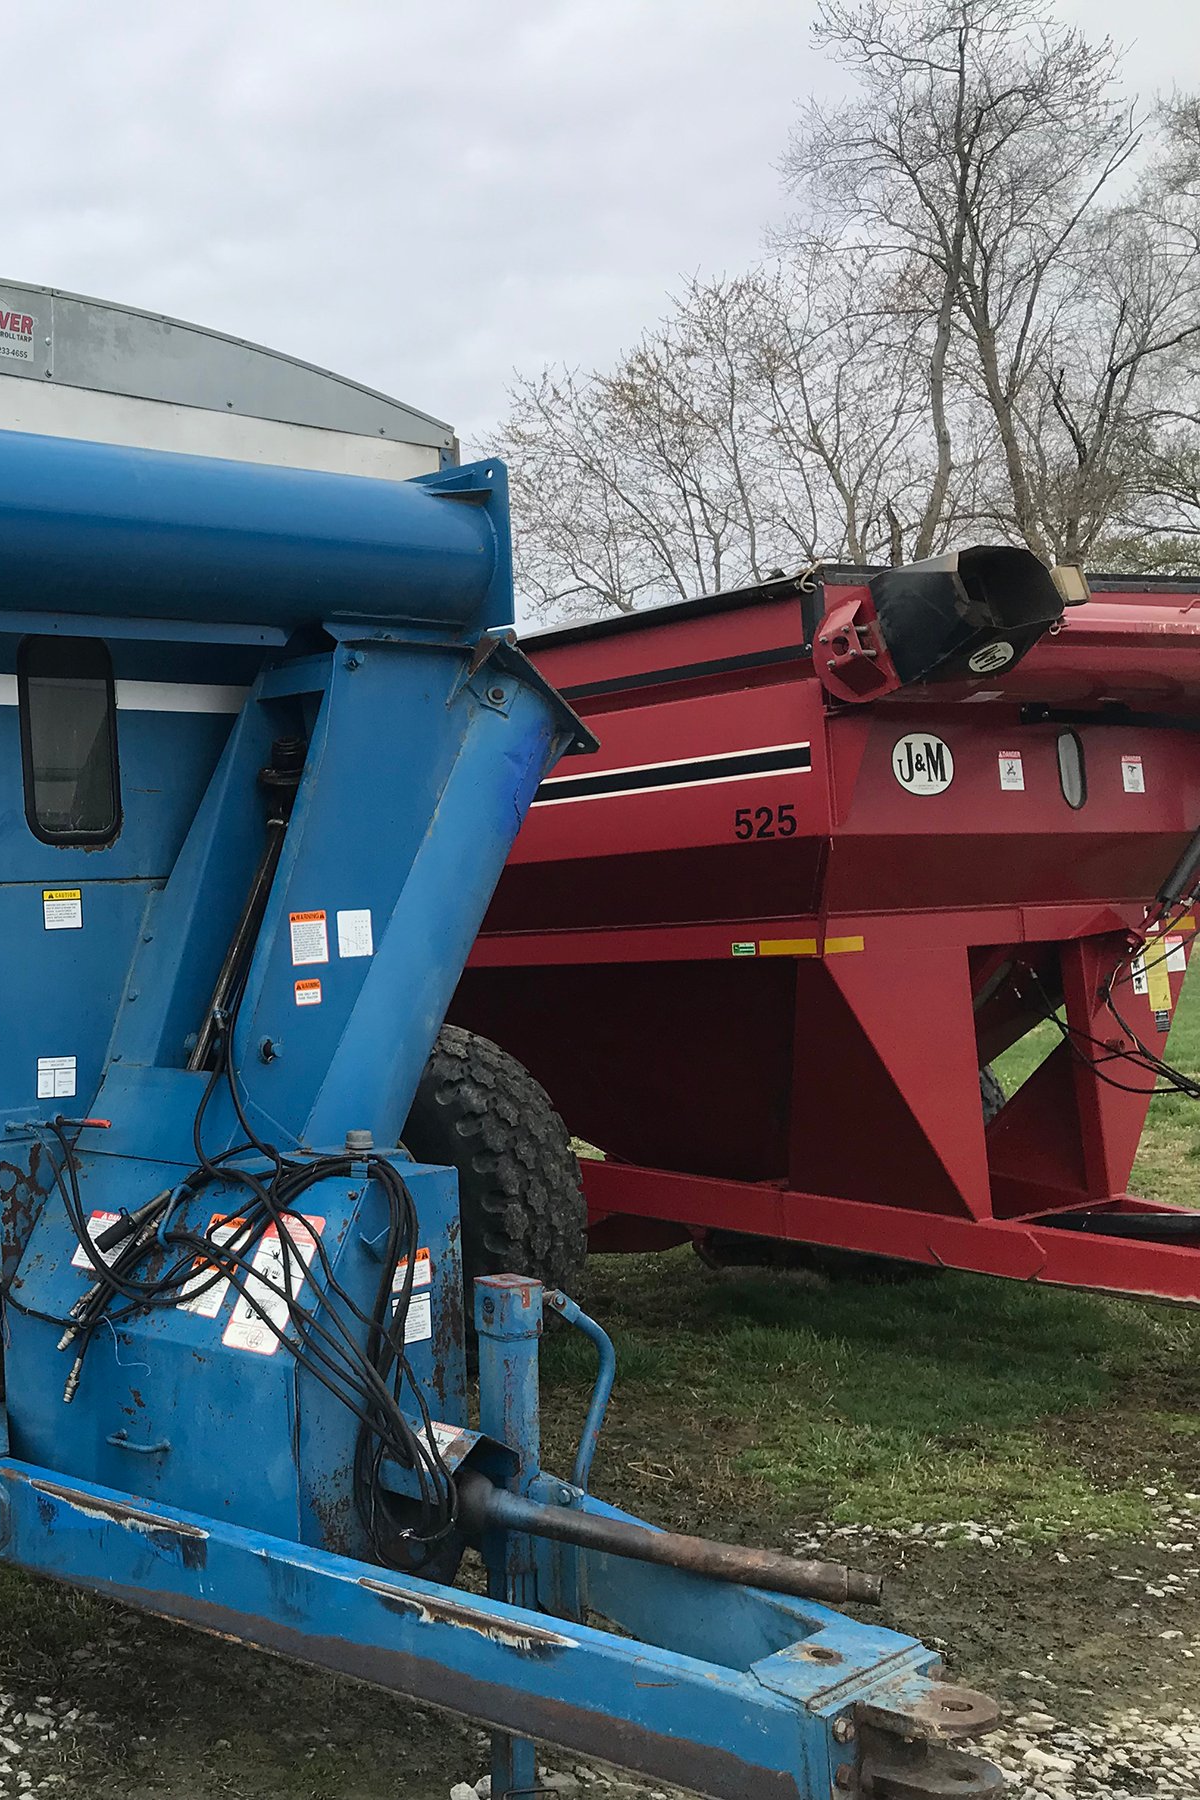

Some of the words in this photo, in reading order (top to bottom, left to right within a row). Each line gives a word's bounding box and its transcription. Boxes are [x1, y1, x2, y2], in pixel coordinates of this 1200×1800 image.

[0, 330, 15, 339] ROLL
[16, 333, 33, 343] TARP
[897, 742, 947, 783] J&M
[735, 804, 797, 840] 525
